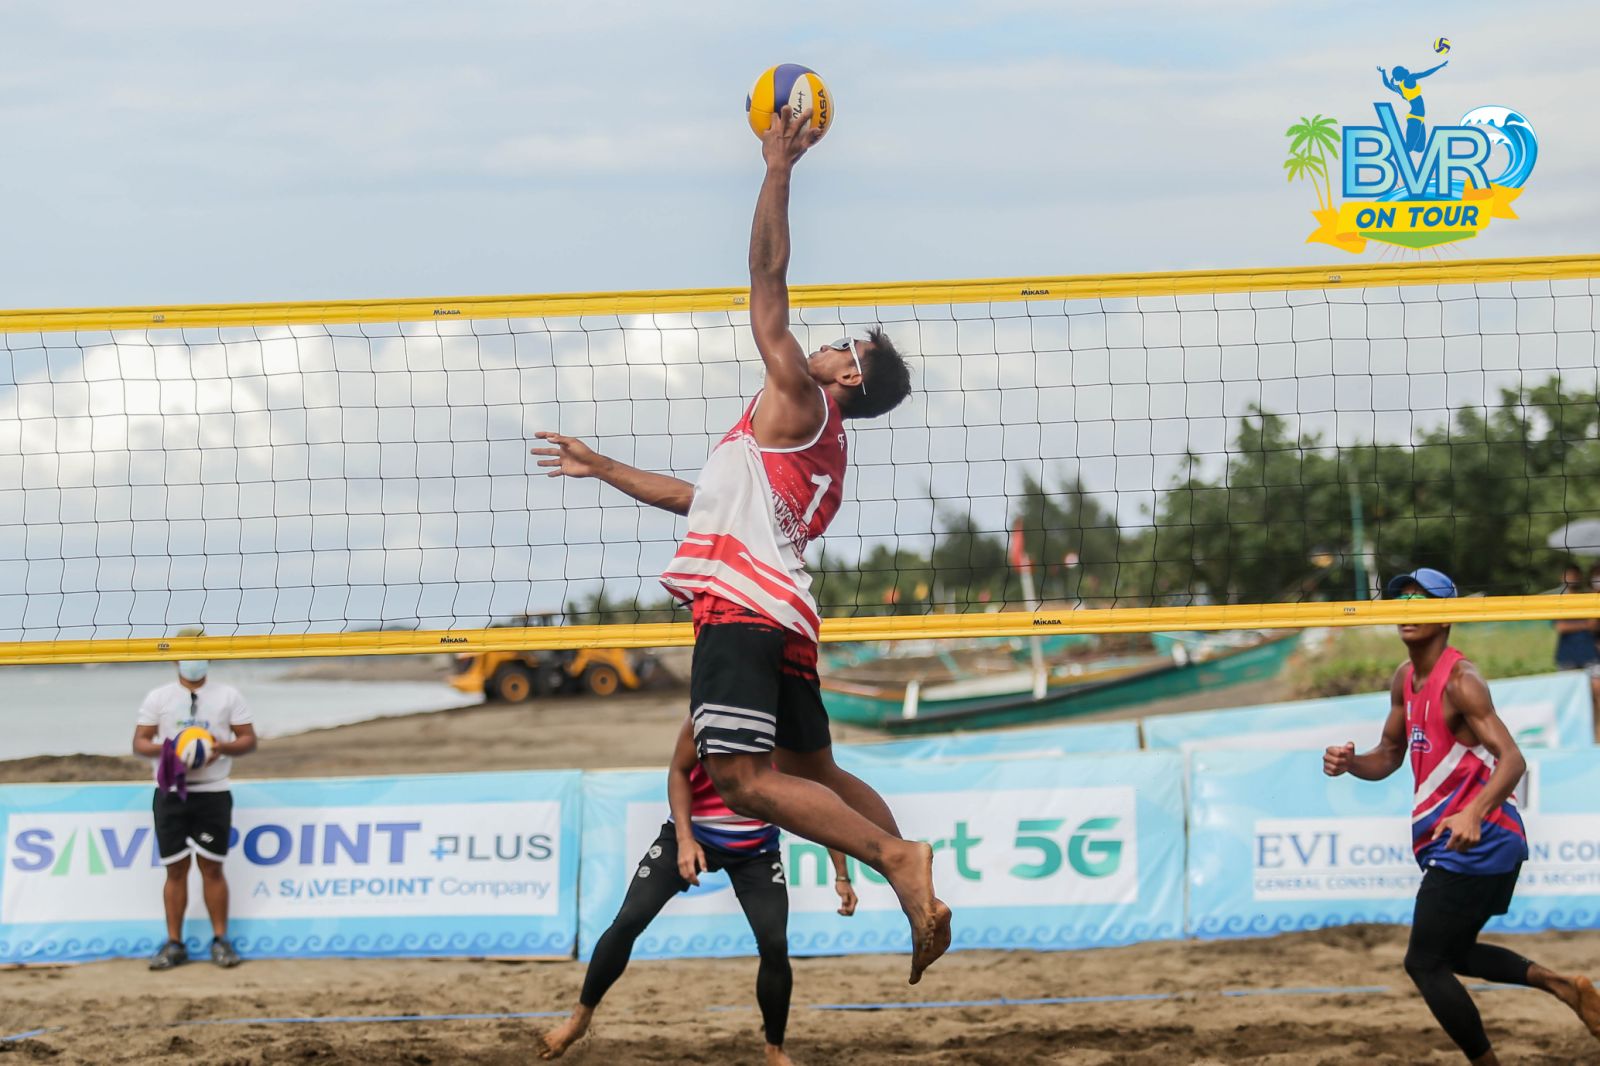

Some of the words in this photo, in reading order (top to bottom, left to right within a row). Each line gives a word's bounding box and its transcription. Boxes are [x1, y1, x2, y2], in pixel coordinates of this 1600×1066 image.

[817, 88, 828, 129] KASA
[12, 822, 422, 876] SAVOINT
[1009, 817, 1123, 879] 5G
[1256, 833, 1341, 868] EVI
[252, 880, 271, 898] A
[279, 876, 434, 900] SAVEPOINT
[440, 876, 551, 900] Company
[1327, 875, 1417, 890] CONSTRUCT
